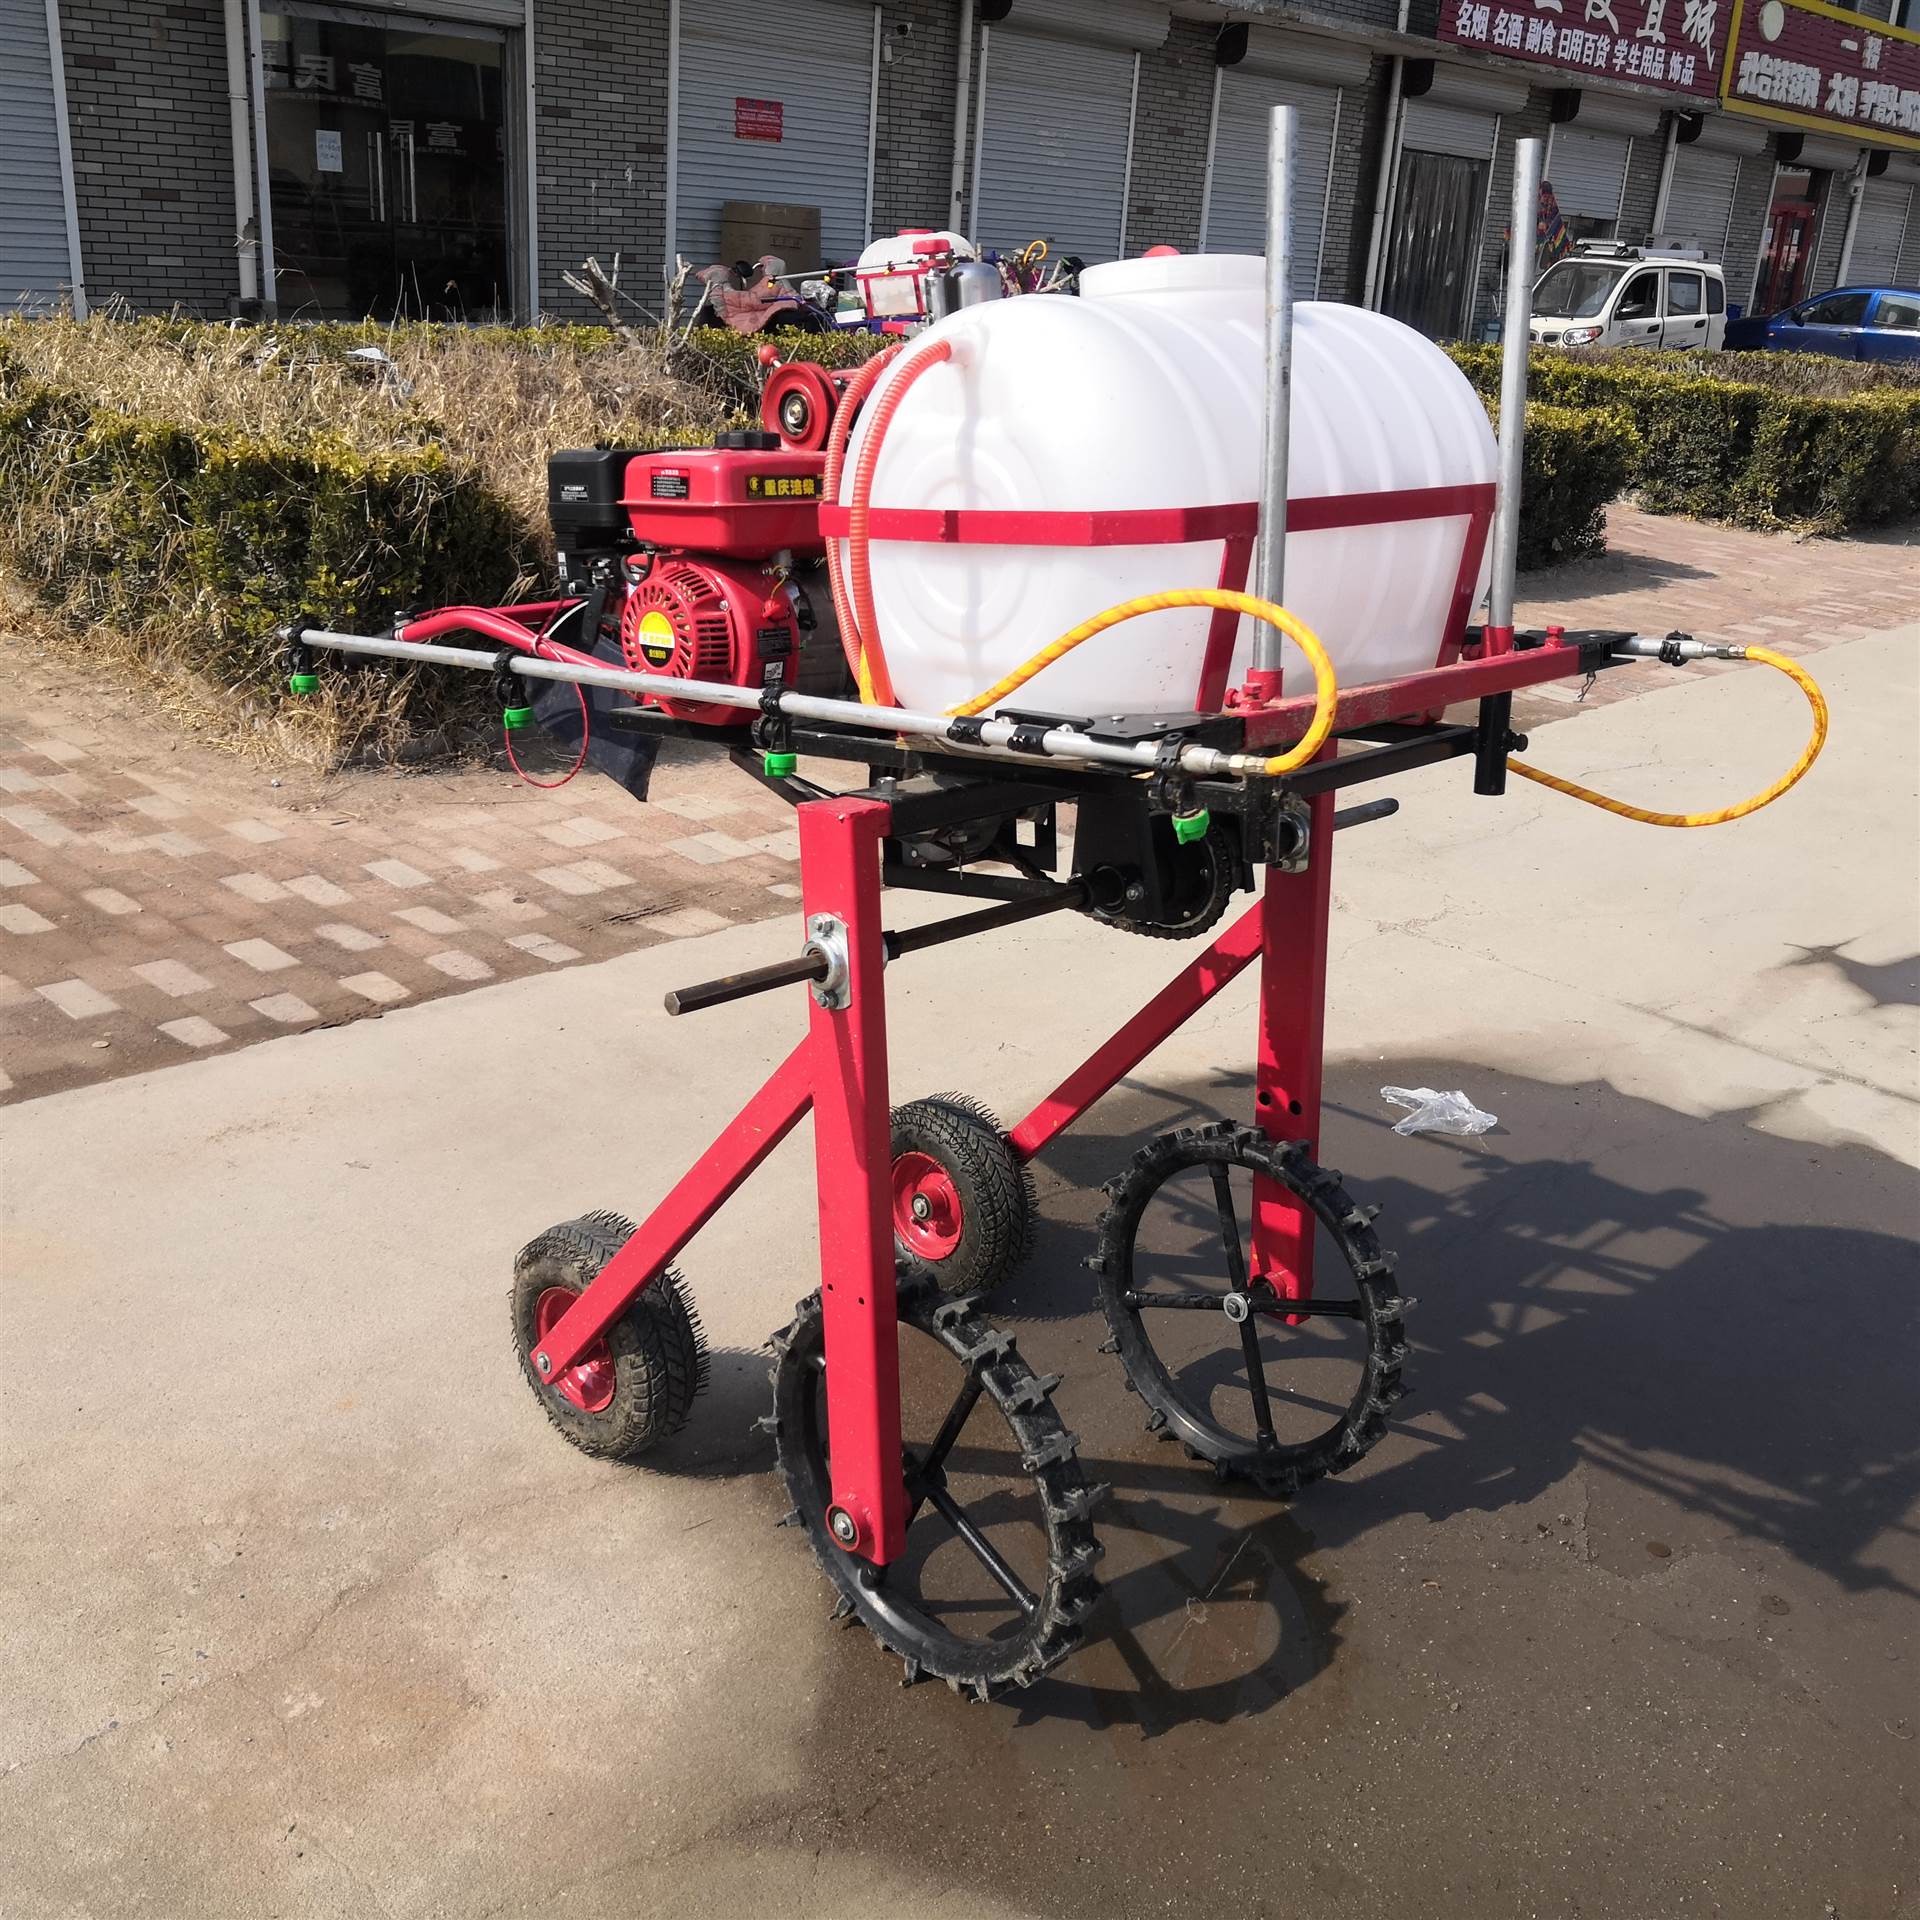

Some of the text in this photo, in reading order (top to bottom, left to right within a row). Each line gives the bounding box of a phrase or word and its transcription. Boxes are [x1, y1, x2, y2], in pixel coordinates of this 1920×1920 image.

[1455, 1, 1696, 86] 名烟 名酒 副食 日用百货 学生用品 饰品
